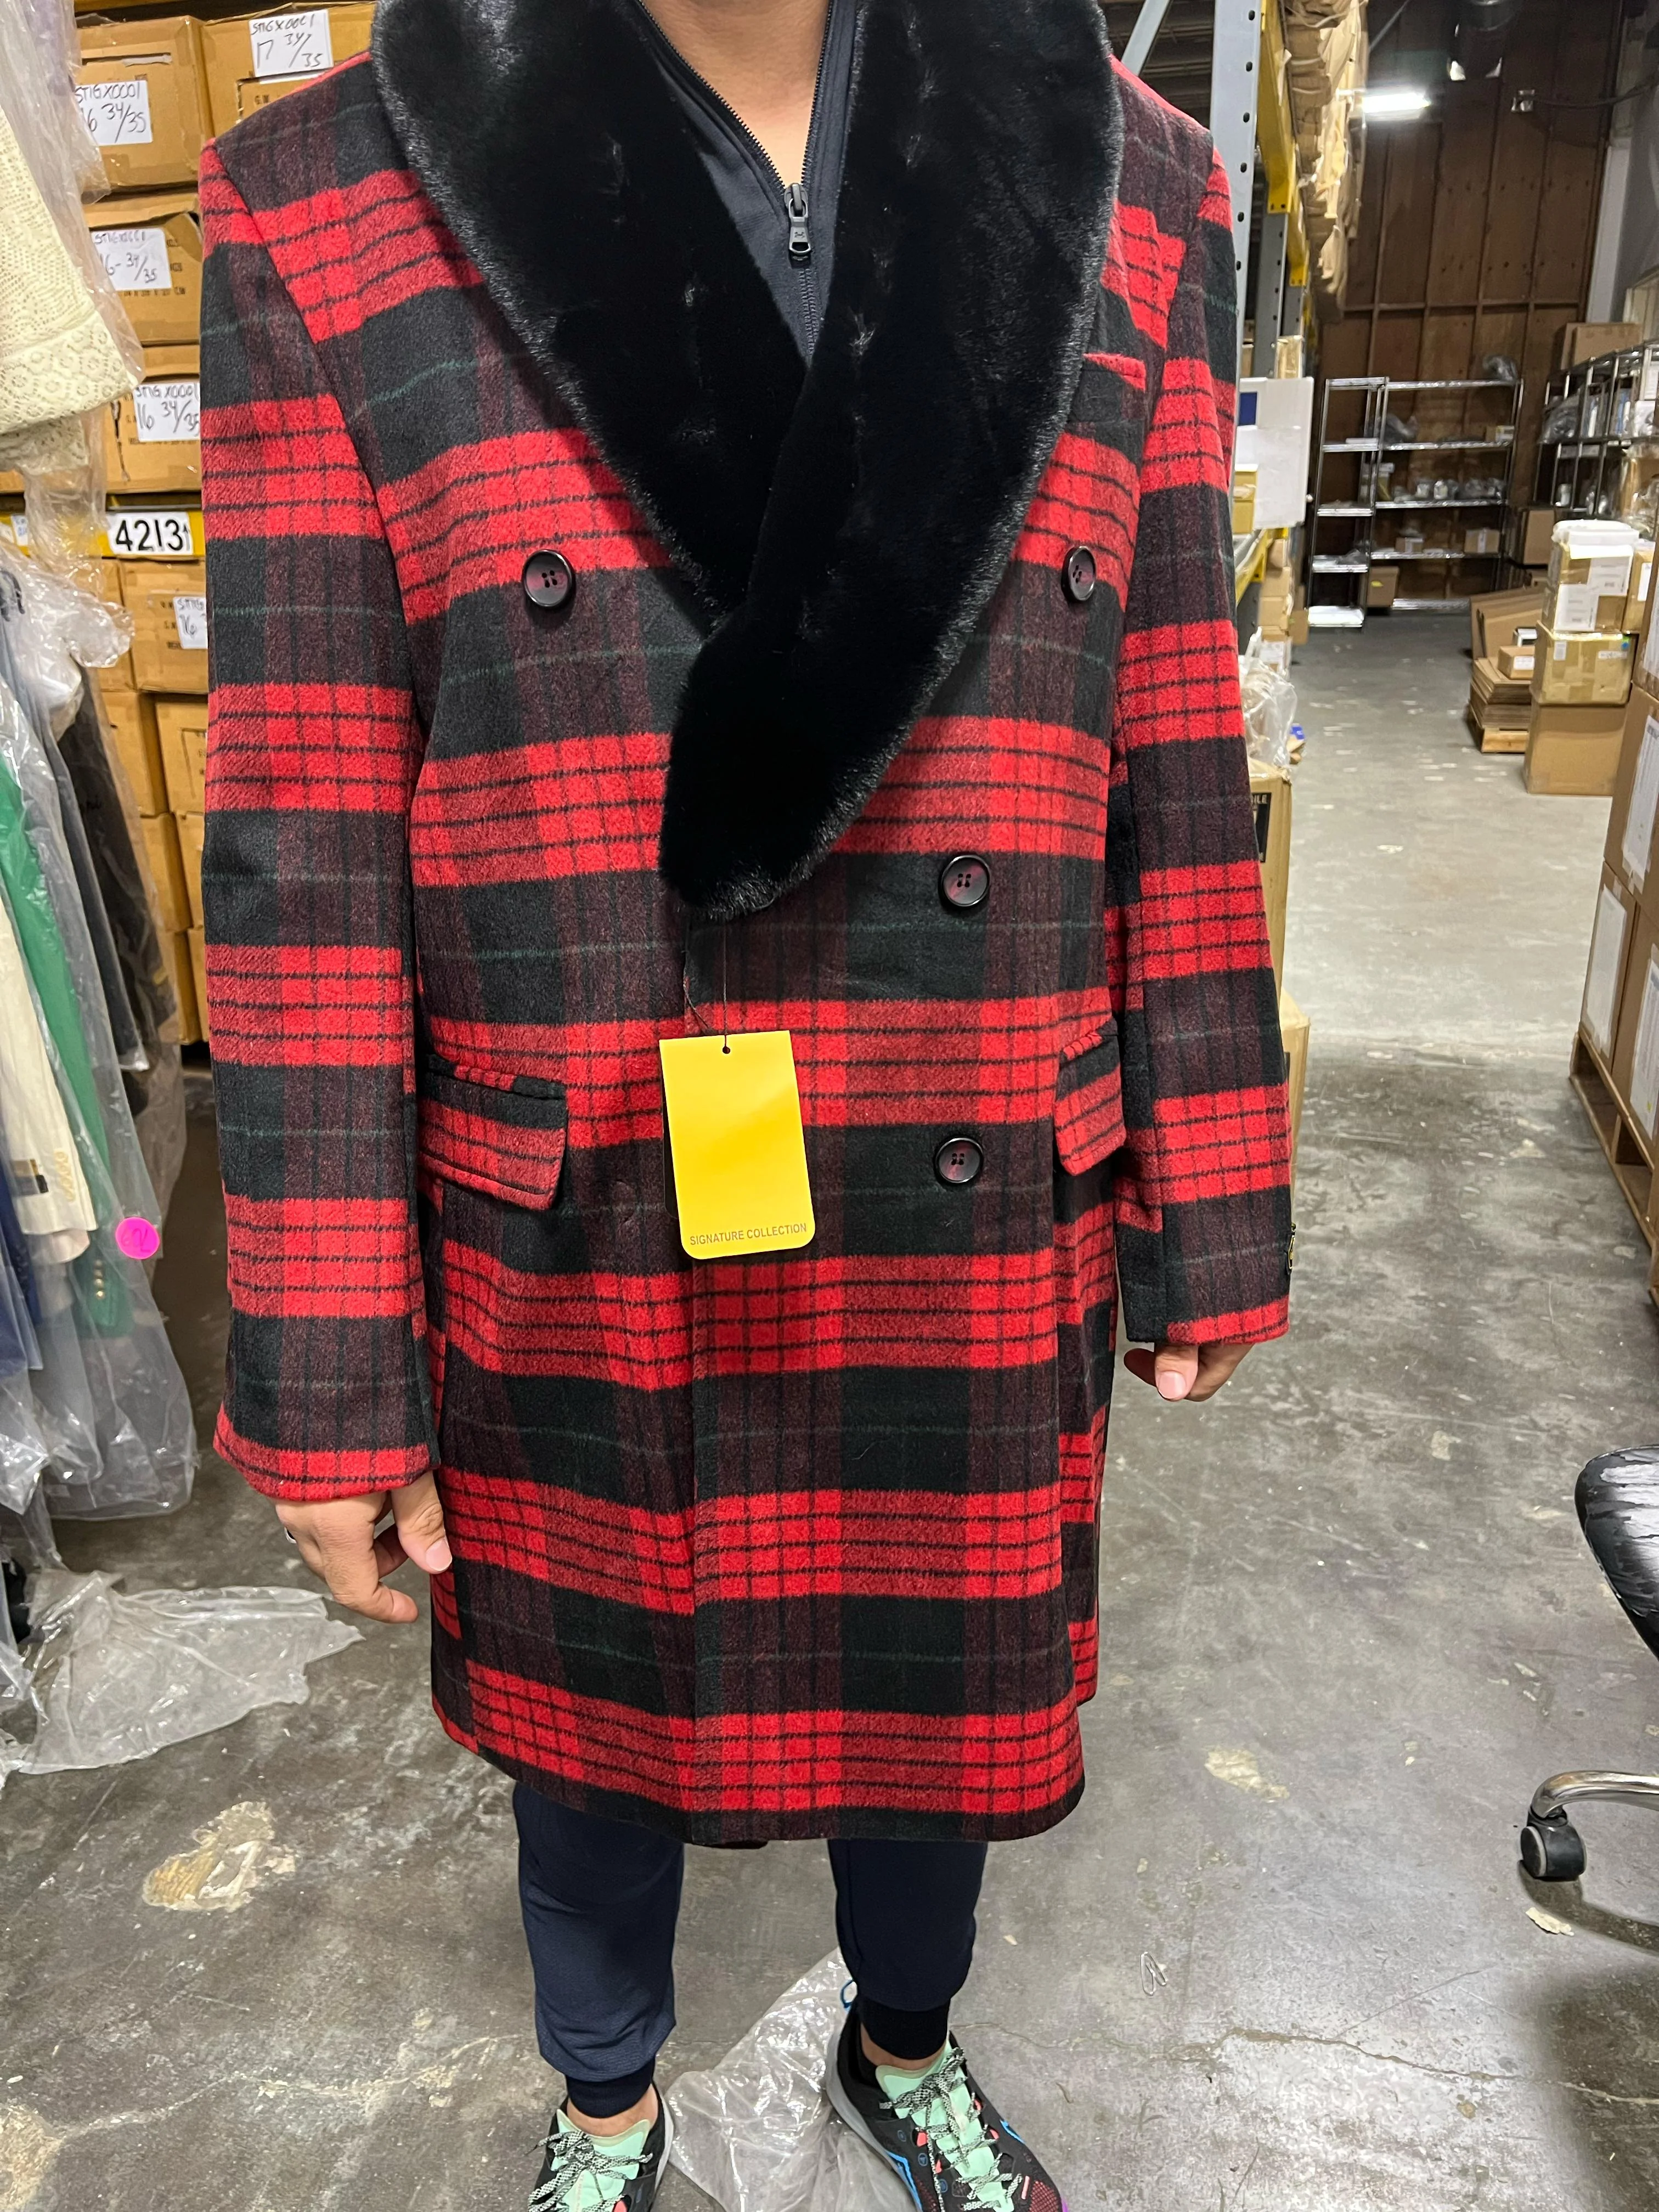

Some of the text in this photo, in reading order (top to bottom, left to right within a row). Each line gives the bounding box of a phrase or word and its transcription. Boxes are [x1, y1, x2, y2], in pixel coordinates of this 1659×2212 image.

[137, 402, 155, 430] 16
[116, 519, 183, 551] 4213
[690, 1223, 807, 1245] SIGNATURE COLLECTION
